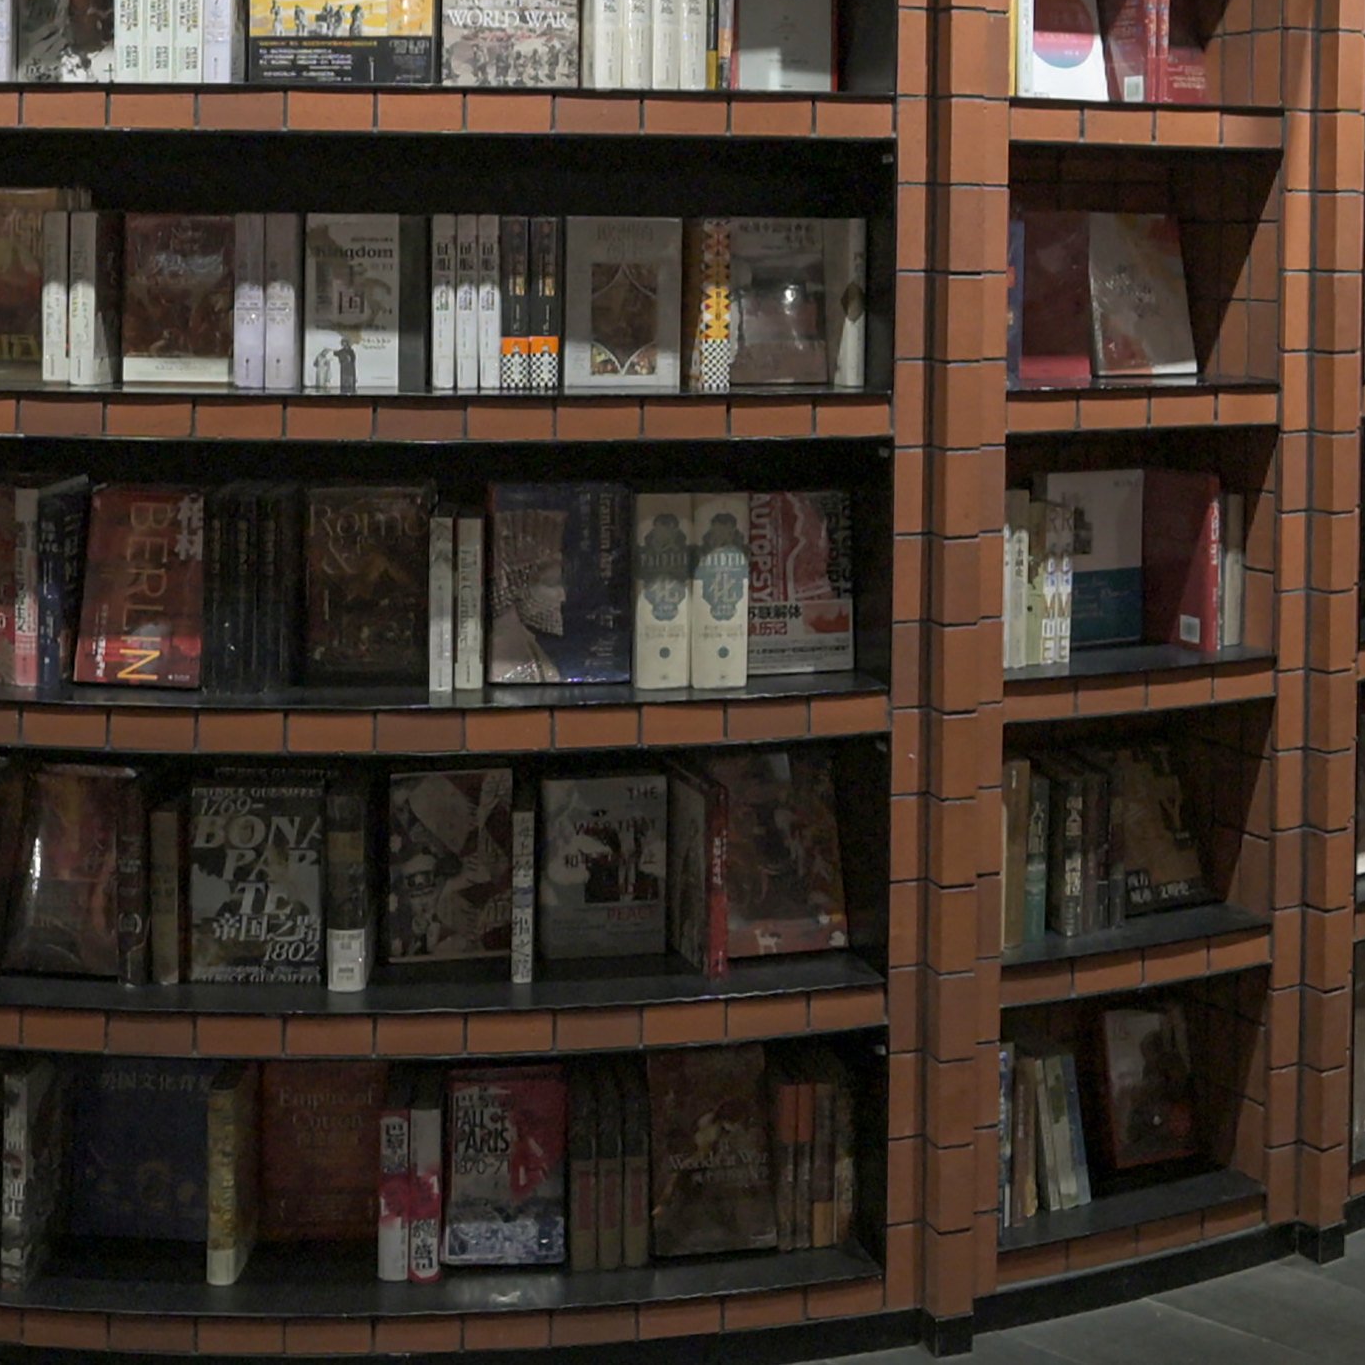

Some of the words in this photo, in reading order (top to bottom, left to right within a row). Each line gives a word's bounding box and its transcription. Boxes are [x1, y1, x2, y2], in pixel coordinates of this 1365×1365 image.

[448, 8, 520, 29] WORLD
[522, 9, 570, 29] WAR
[750, 493, 773, 603] AUTOPSY
[116, 501, 172, 681] BERLIN
[626, 787, 659, 800] THE
[263, 942, 319, 962] 1802
[279, 1086, 351, 1110] Empire
[354, 1089, 373, 1107] of
[455, 1129, 510, 1154] PARIS
